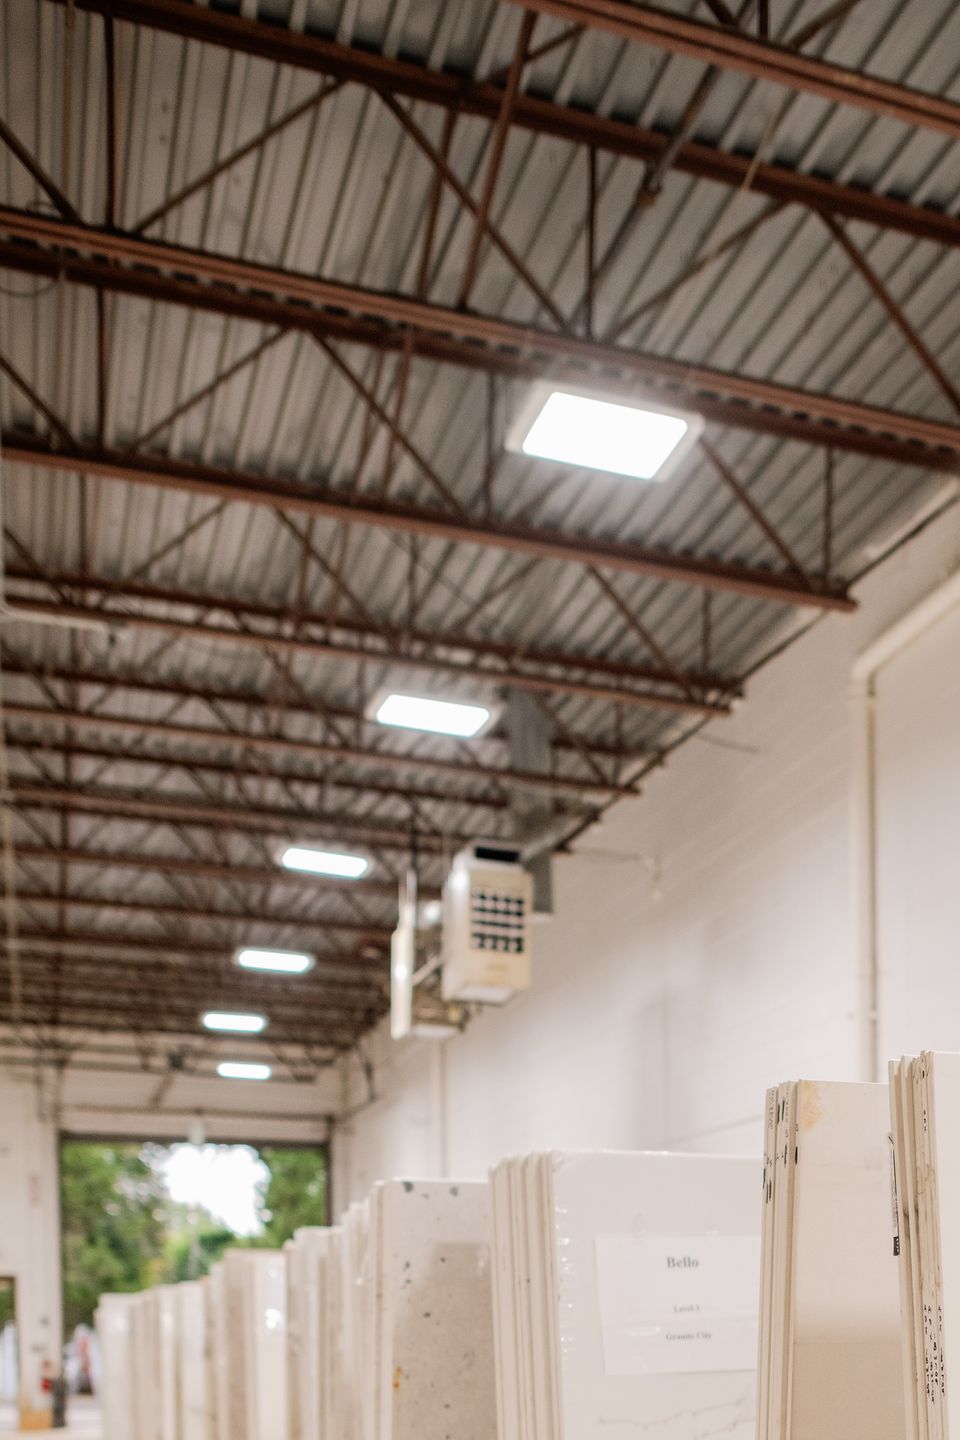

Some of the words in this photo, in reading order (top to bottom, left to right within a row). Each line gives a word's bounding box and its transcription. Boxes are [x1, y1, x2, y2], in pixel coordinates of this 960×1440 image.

[666, 1256, 700, 1269] Bello
[665, 1332, 695, 1342] Granite
[696, 1331, 712, 1342] City
